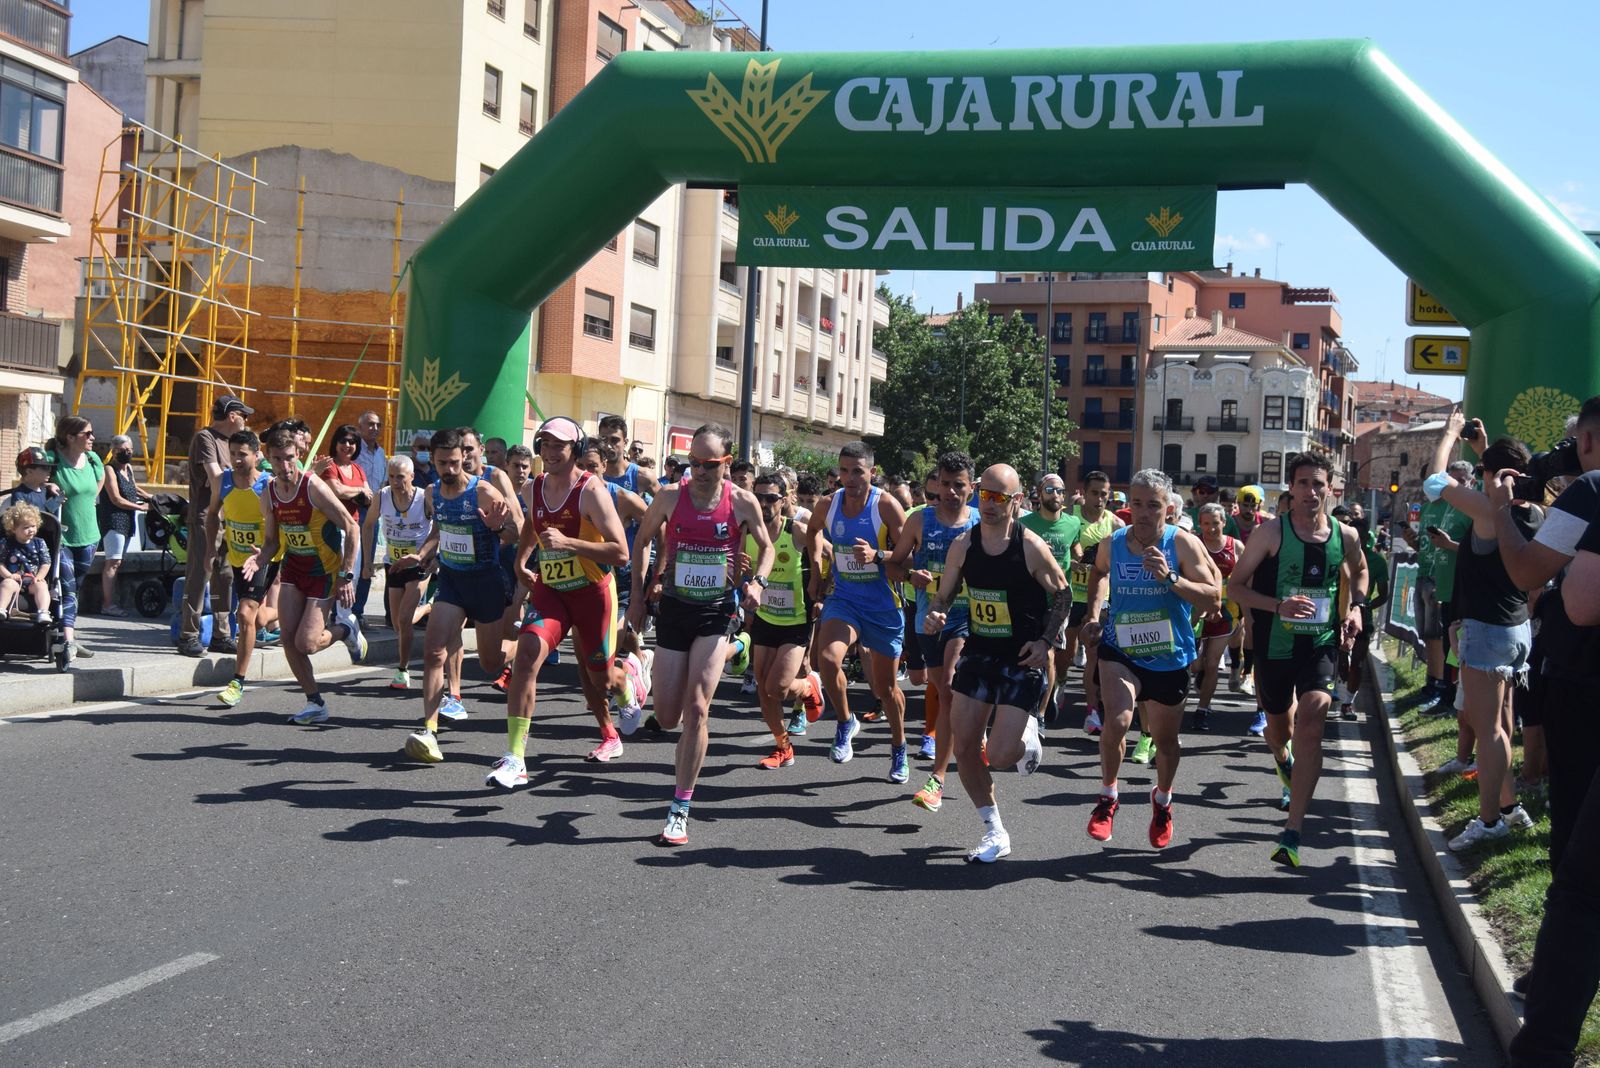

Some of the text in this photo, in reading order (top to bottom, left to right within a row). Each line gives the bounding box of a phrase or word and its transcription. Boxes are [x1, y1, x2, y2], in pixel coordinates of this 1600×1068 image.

[834, 69, 1265, 136] CAJA RURAL
[823, 204, 1117, 253] SALIDA
[752, 237, 810, 248] CAJA RURAL
[1131, 240, 1196, 251] CAJA RURAL
[1418, 304, 1449, 314] hote
[232, 529, 256, 544] 139
[285, 532, 309, 546] 182
[450, 542, 468, 552] NIETO
[544, 560, 575, 580] 227
[684, 574, 716, 587] GARGAR
[1117, 586, 1169, 596] ATLETISMO
[767, 595, 786, 606] JORGE
[976, 602, 997, 623] 49
[1130, 630, 1160, 645] MANSO
